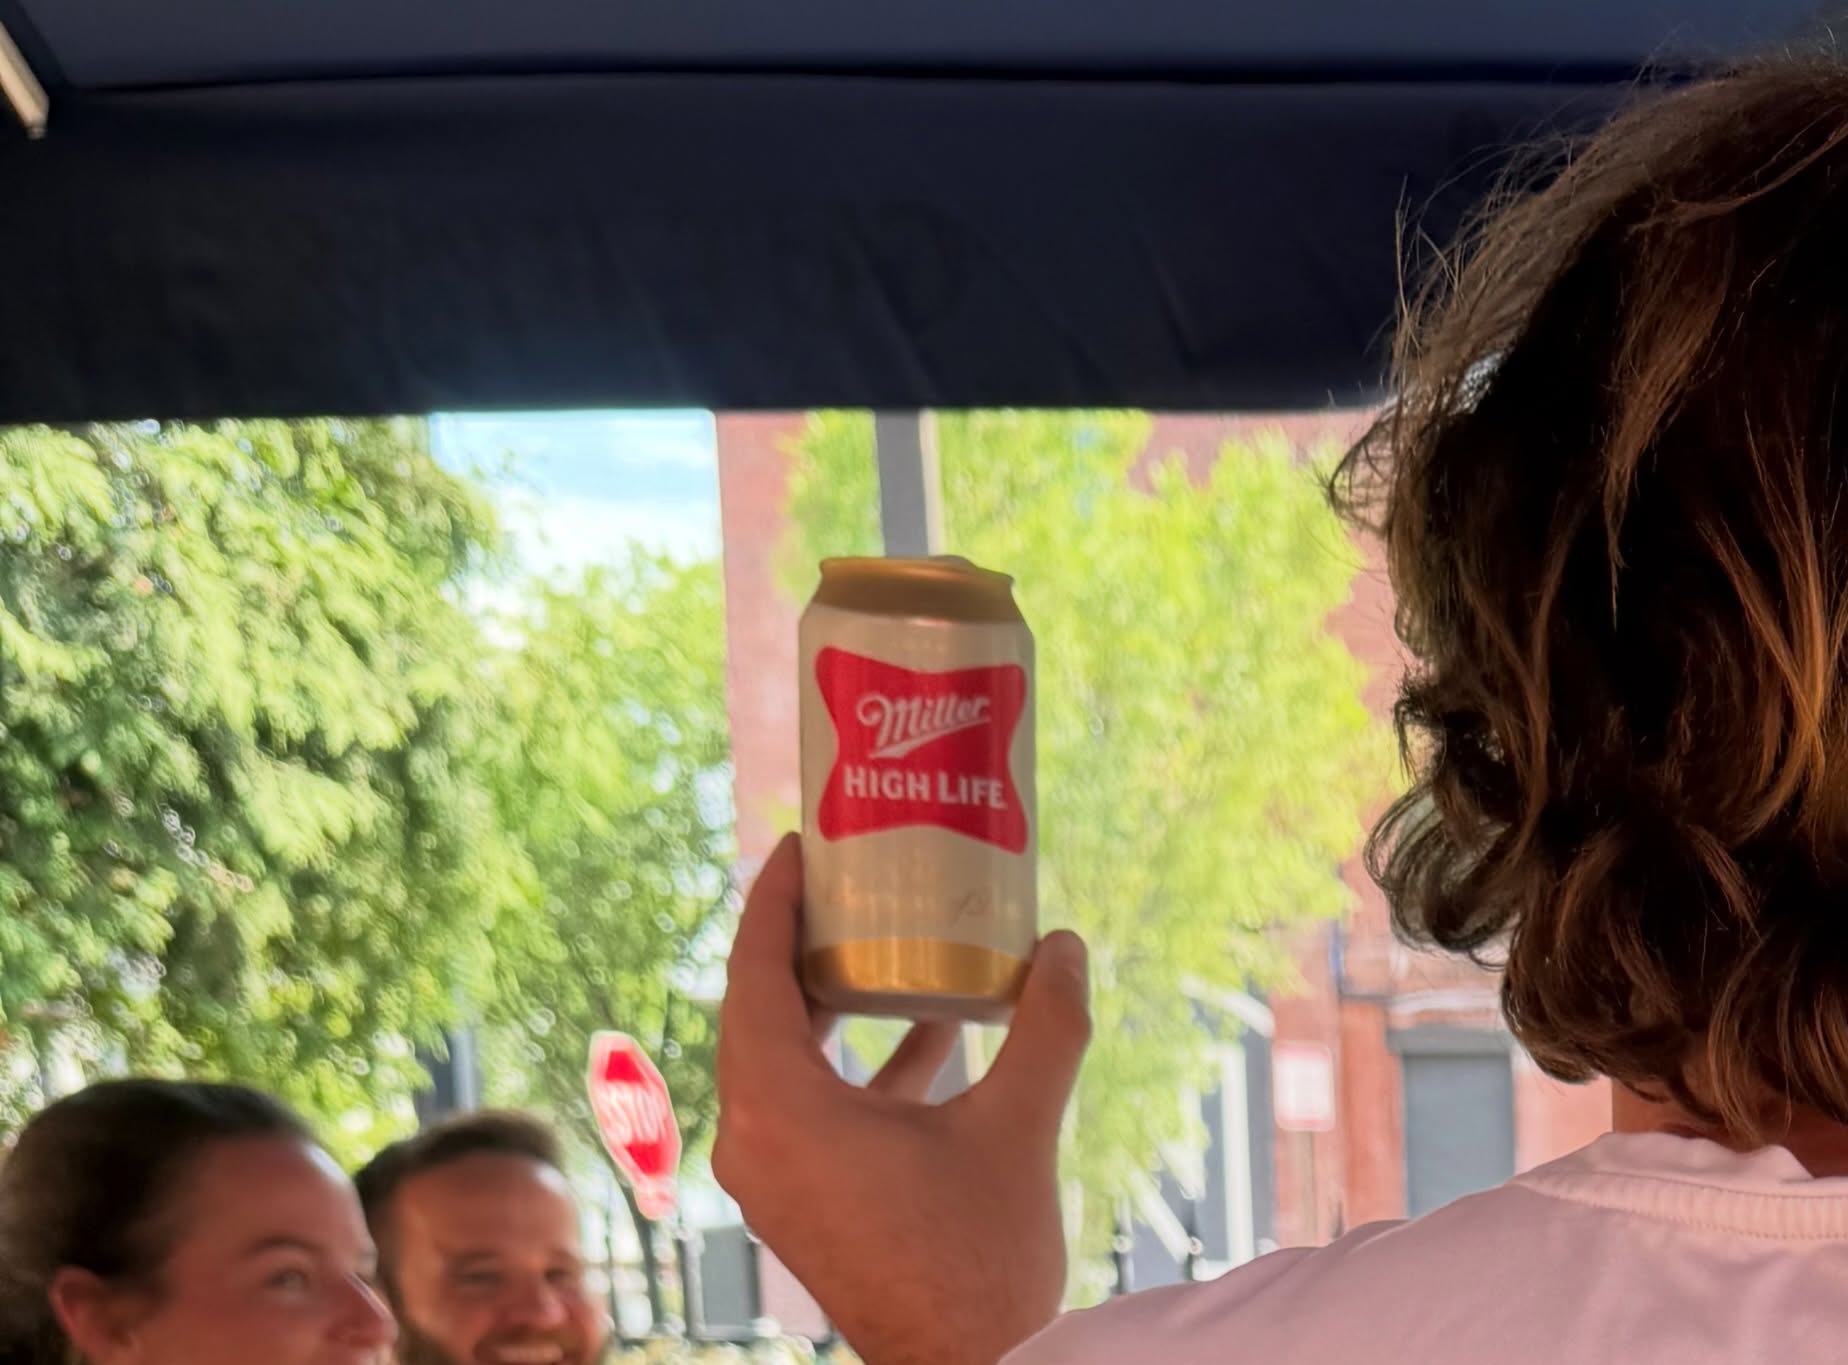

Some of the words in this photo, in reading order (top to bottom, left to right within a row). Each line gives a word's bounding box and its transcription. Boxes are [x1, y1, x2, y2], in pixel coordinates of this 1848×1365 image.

[856, 692, 992, 758] Miller
[843, 764, 930, 801] HIGH
[937, 769, 1008, 809] LIFE
